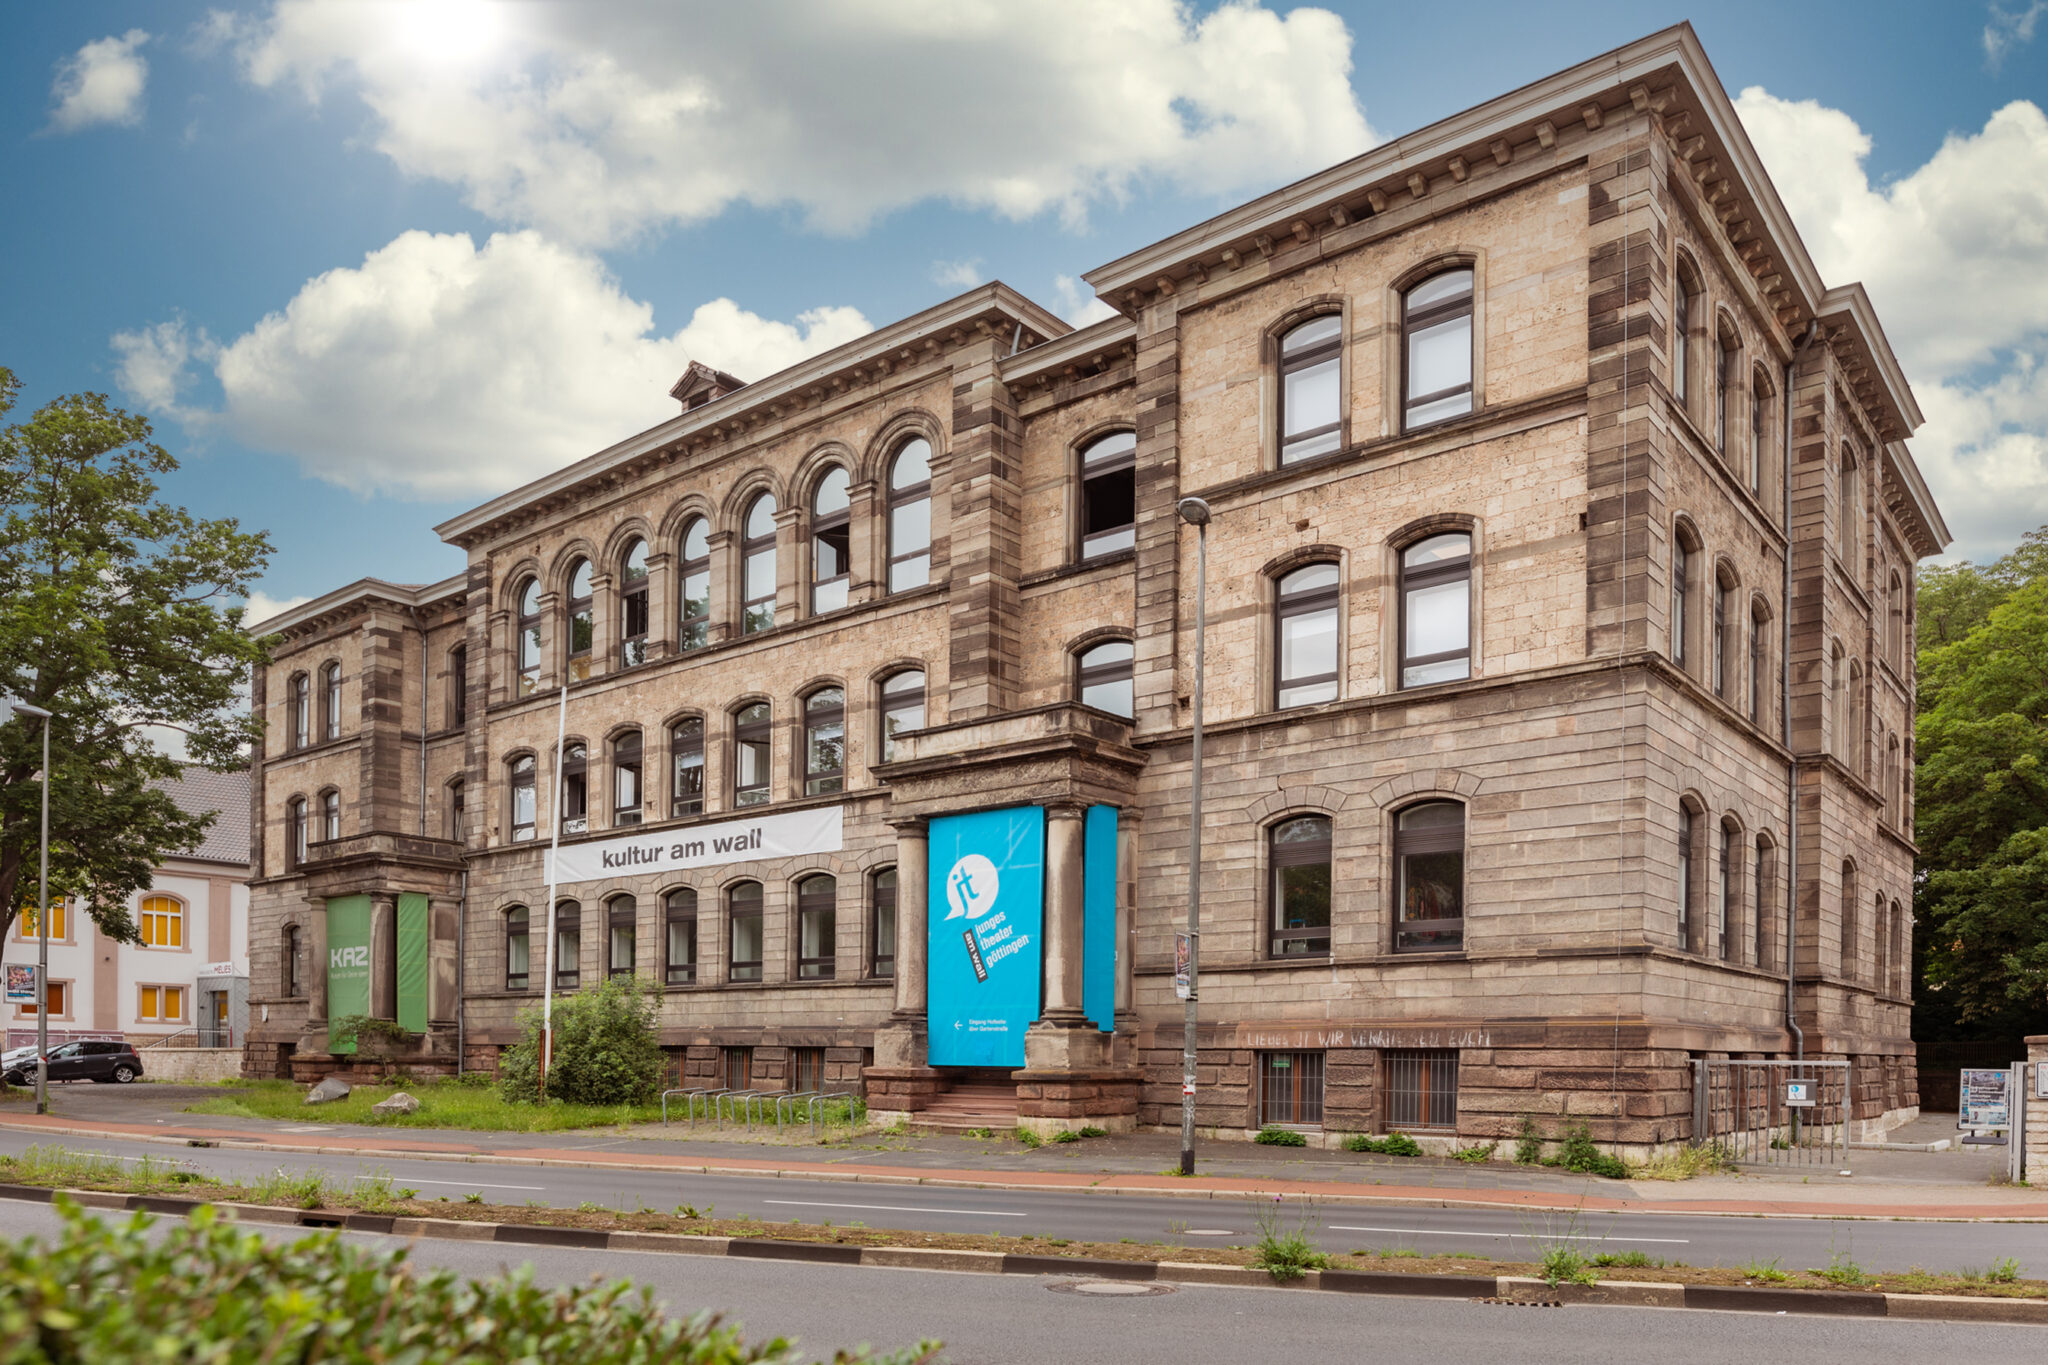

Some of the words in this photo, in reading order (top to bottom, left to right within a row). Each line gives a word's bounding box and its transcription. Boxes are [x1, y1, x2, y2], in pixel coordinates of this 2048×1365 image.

[602, 846, 664, 868] kultur
[671, 840, 705, 860] am
[712, 828, 762, 854] wall
[975, 911, 1006, 938] junges
[980, 925, 1013, 951] theater
[330, 946, 369, 968] KAZ
[965, 933, 976, 952] am
[973, 952, 987, 979] wall
[985, 935, 1030, 968] göttingen
[1318, 1031, 1344, 1048] WIR
